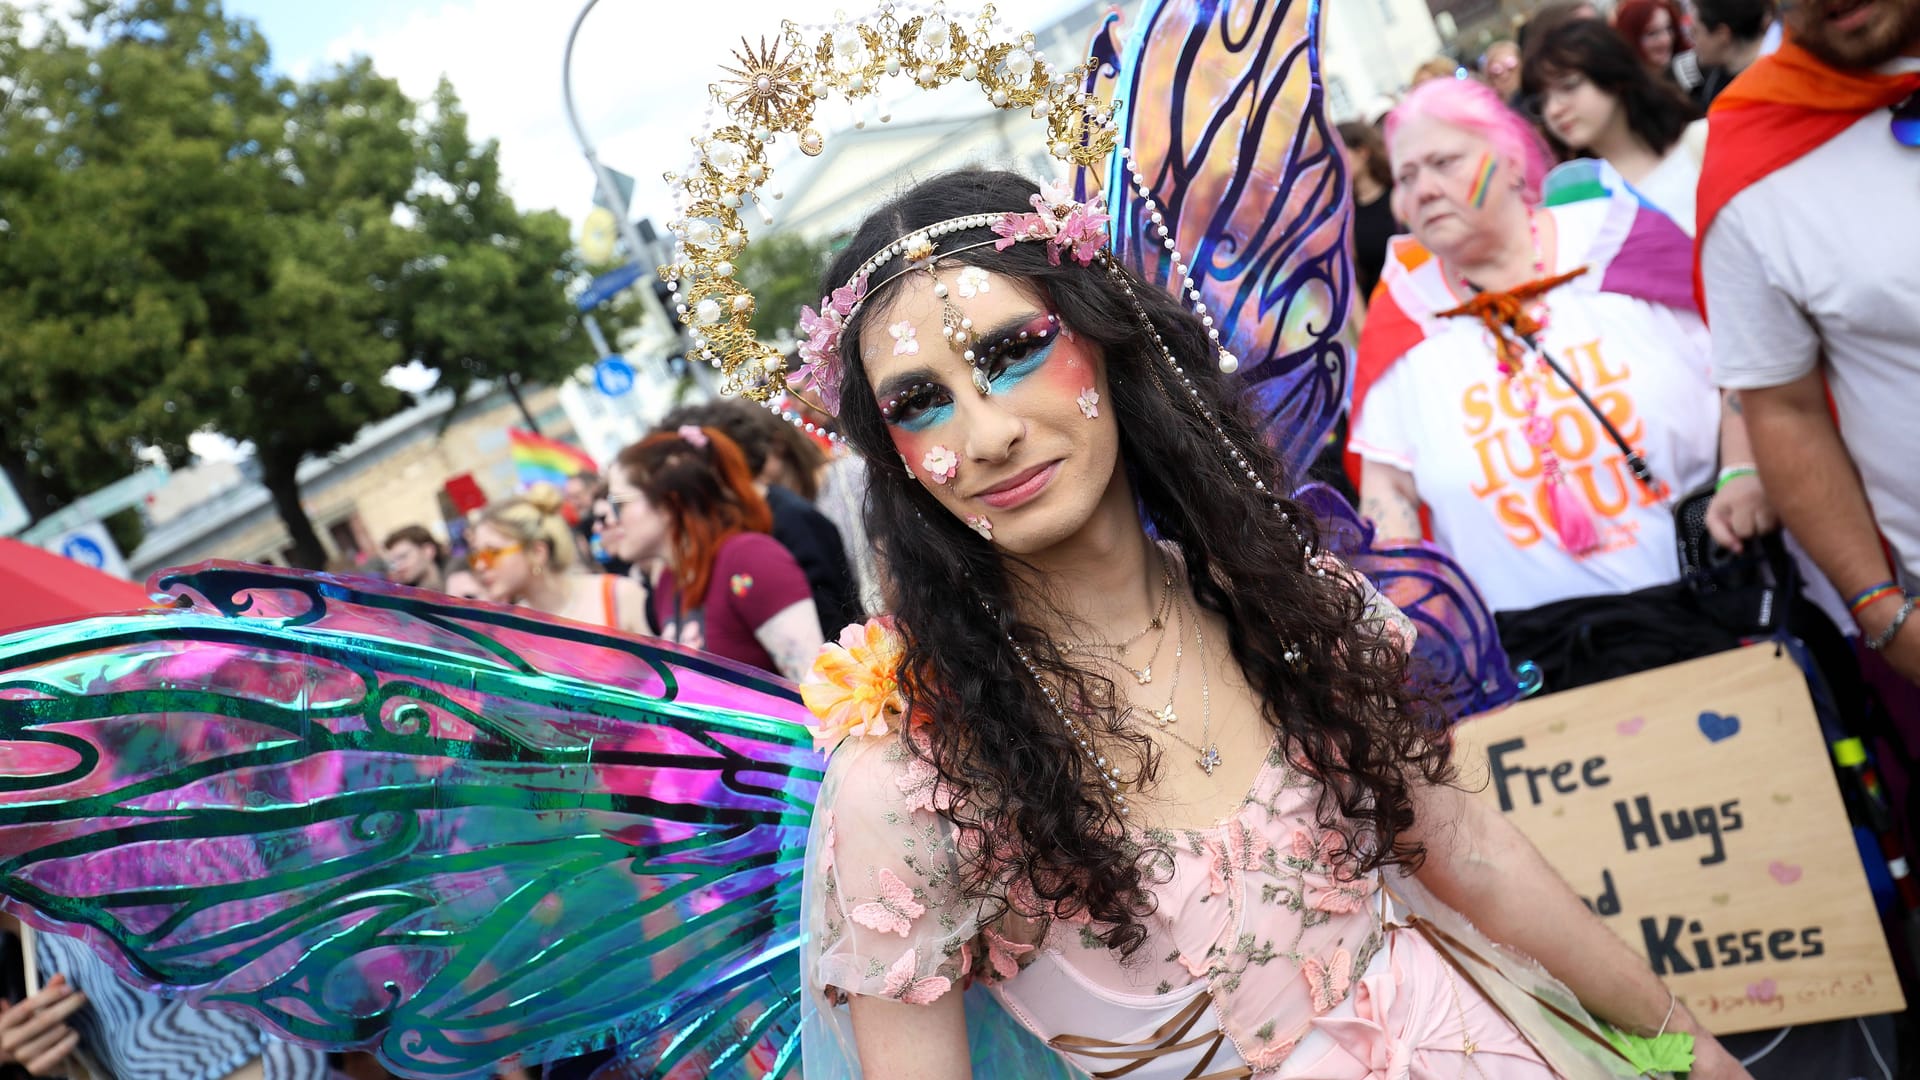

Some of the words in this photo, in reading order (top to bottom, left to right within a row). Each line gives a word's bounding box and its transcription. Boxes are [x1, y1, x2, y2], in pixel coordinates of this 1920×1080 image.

[1487, 737, 1611, 811] Free
[1614, 795, 1744, 866] Hugs
[1640, 916, 1826, 977] Kisses
